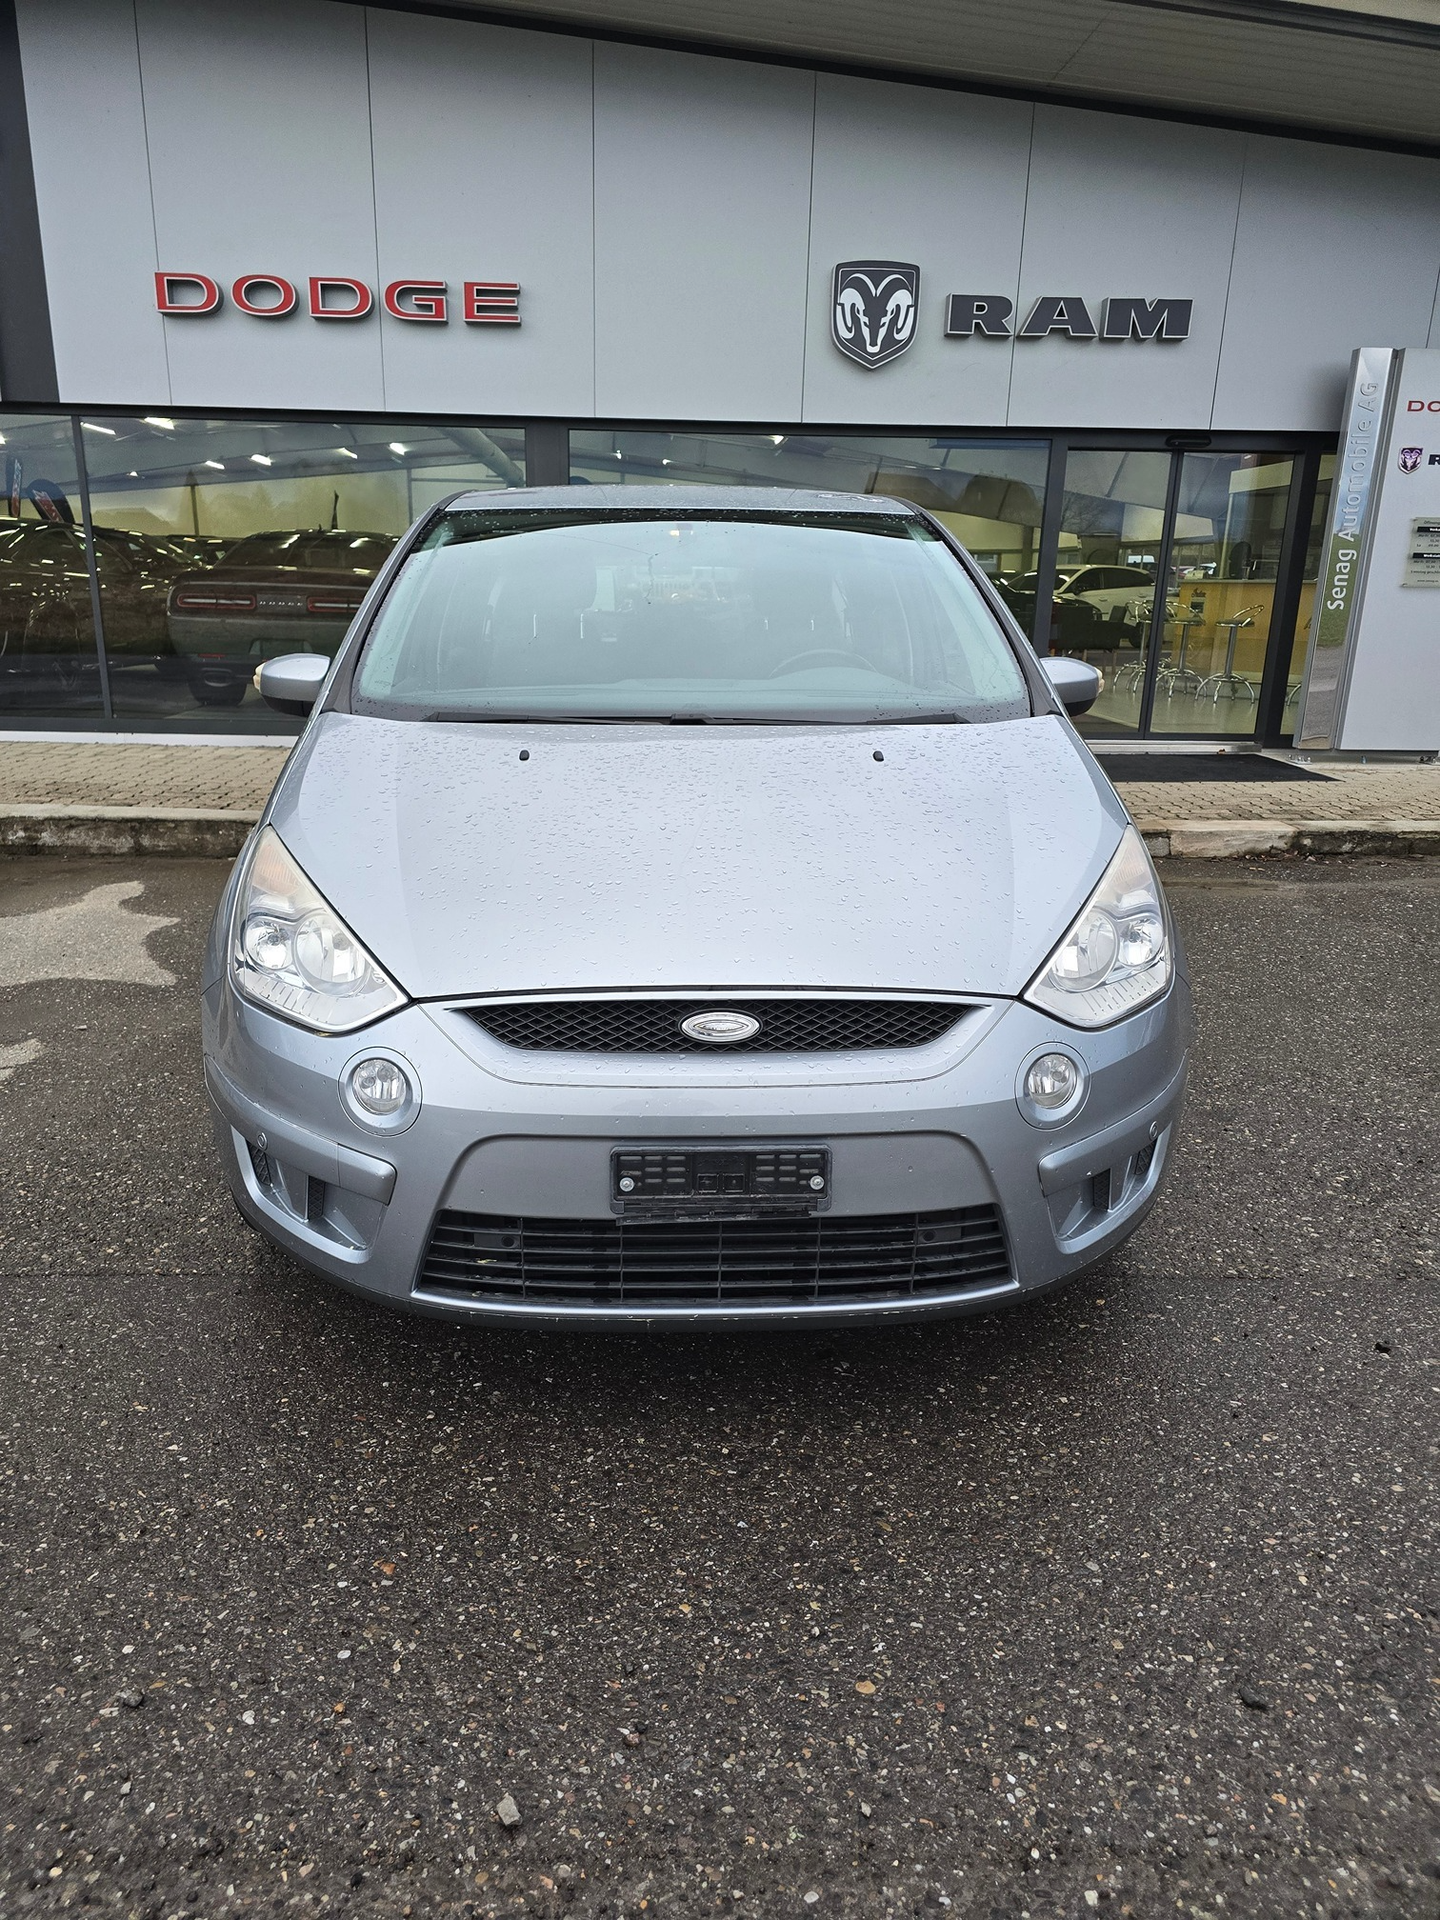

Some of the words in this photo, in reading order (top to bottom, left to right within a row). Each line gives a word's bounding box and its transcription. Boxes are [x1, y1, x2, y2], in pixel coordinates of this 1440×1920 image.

[154, 272, 521, 323] DODGE
[944, 293, 1194, 340] RAM
[1357, 382, 1379, 413] AG
[1338, 419, 1372, 542] Automobile
[1327, 549, 1358, 610] Senag
